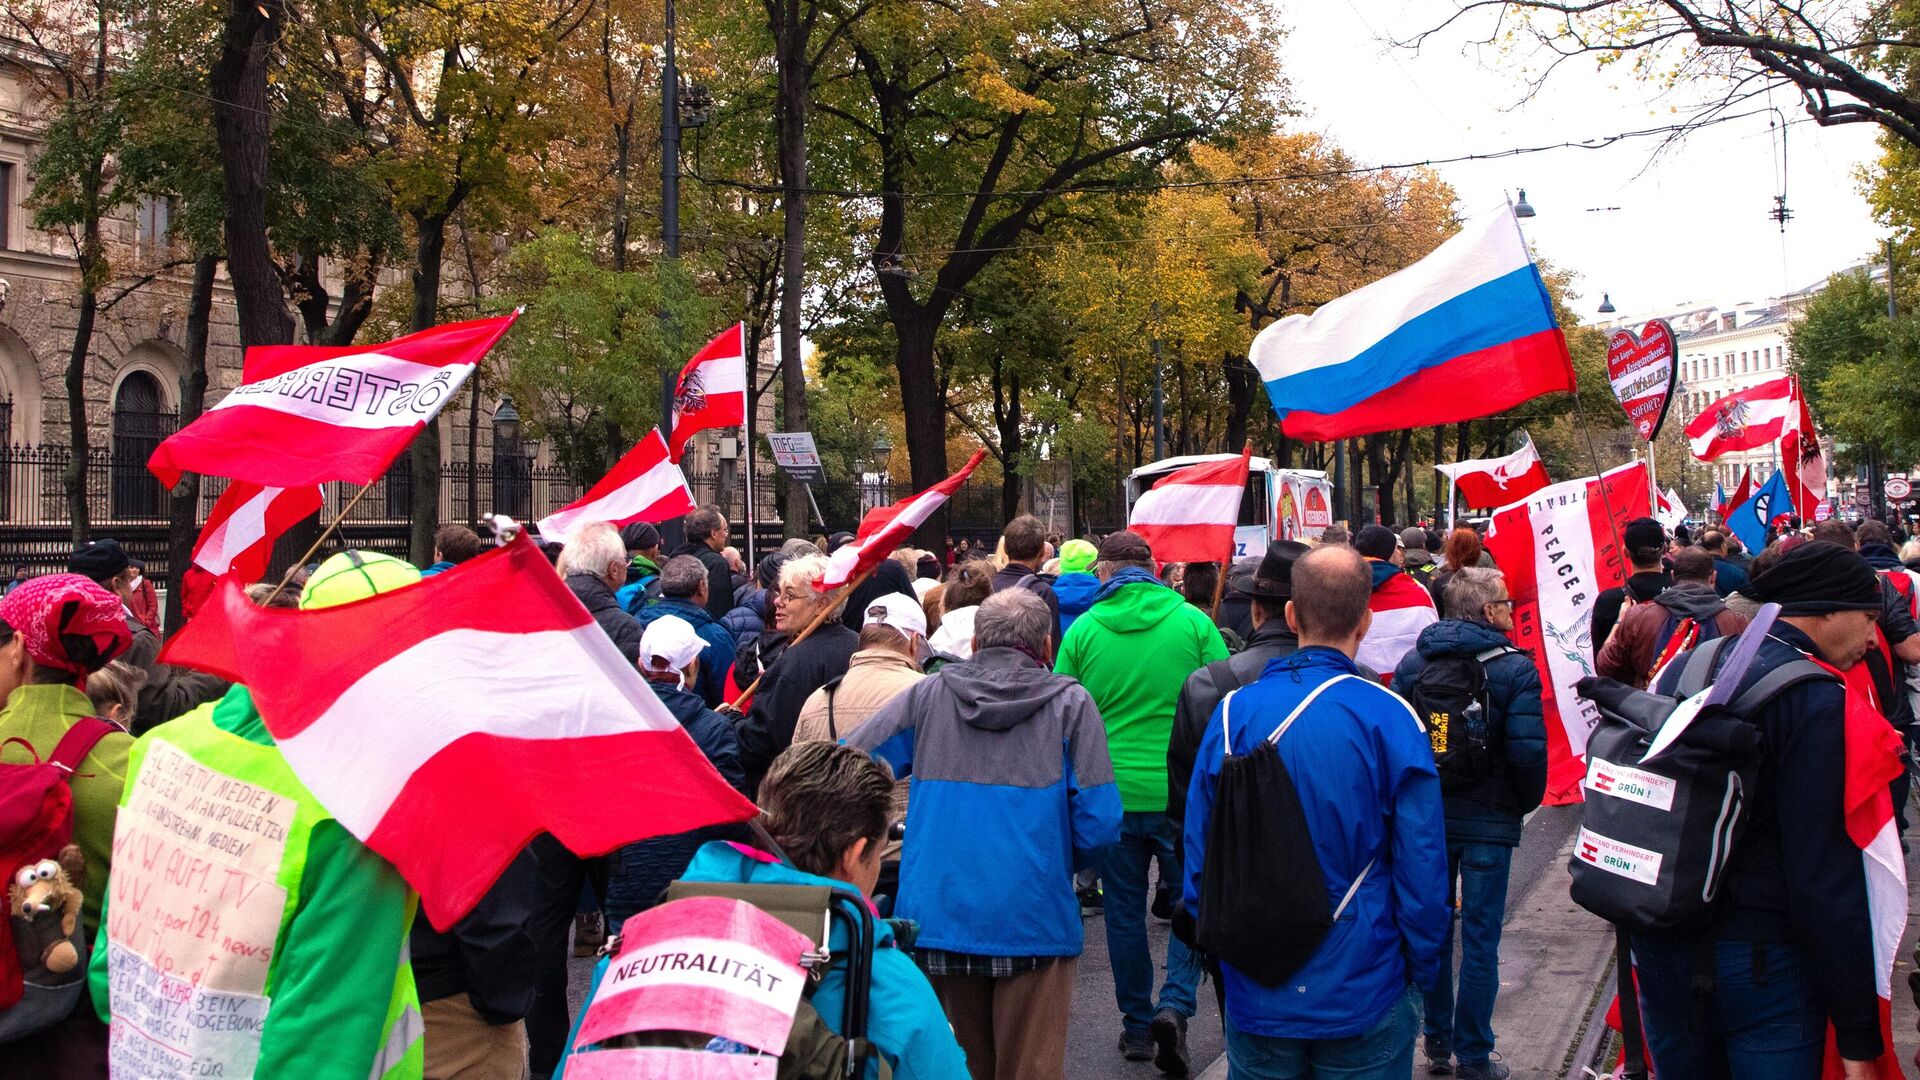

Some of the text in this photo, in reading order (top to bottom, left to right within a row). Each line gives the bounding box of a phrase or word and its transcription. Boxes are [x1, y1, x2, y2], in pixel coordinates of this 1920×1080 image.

[772, 437, 795, 451] MFG
[1541, 524, 1586, 607] PEACE &
[1520, 610, 1533, 637] NO
[1430, 730, 1439, 752] Jack
[1438, 712, 1449, 753] Wolfskin
[1617, 782, 1645, 796] GRÜN
[1604, 855, 1631, 871] GRÜN
[1611, 844, 1655, 862] VERHINDERT
[612, 952, 782, 993] NEUTRALITÄT
[190, 1057, 224, 1077] FÜR
